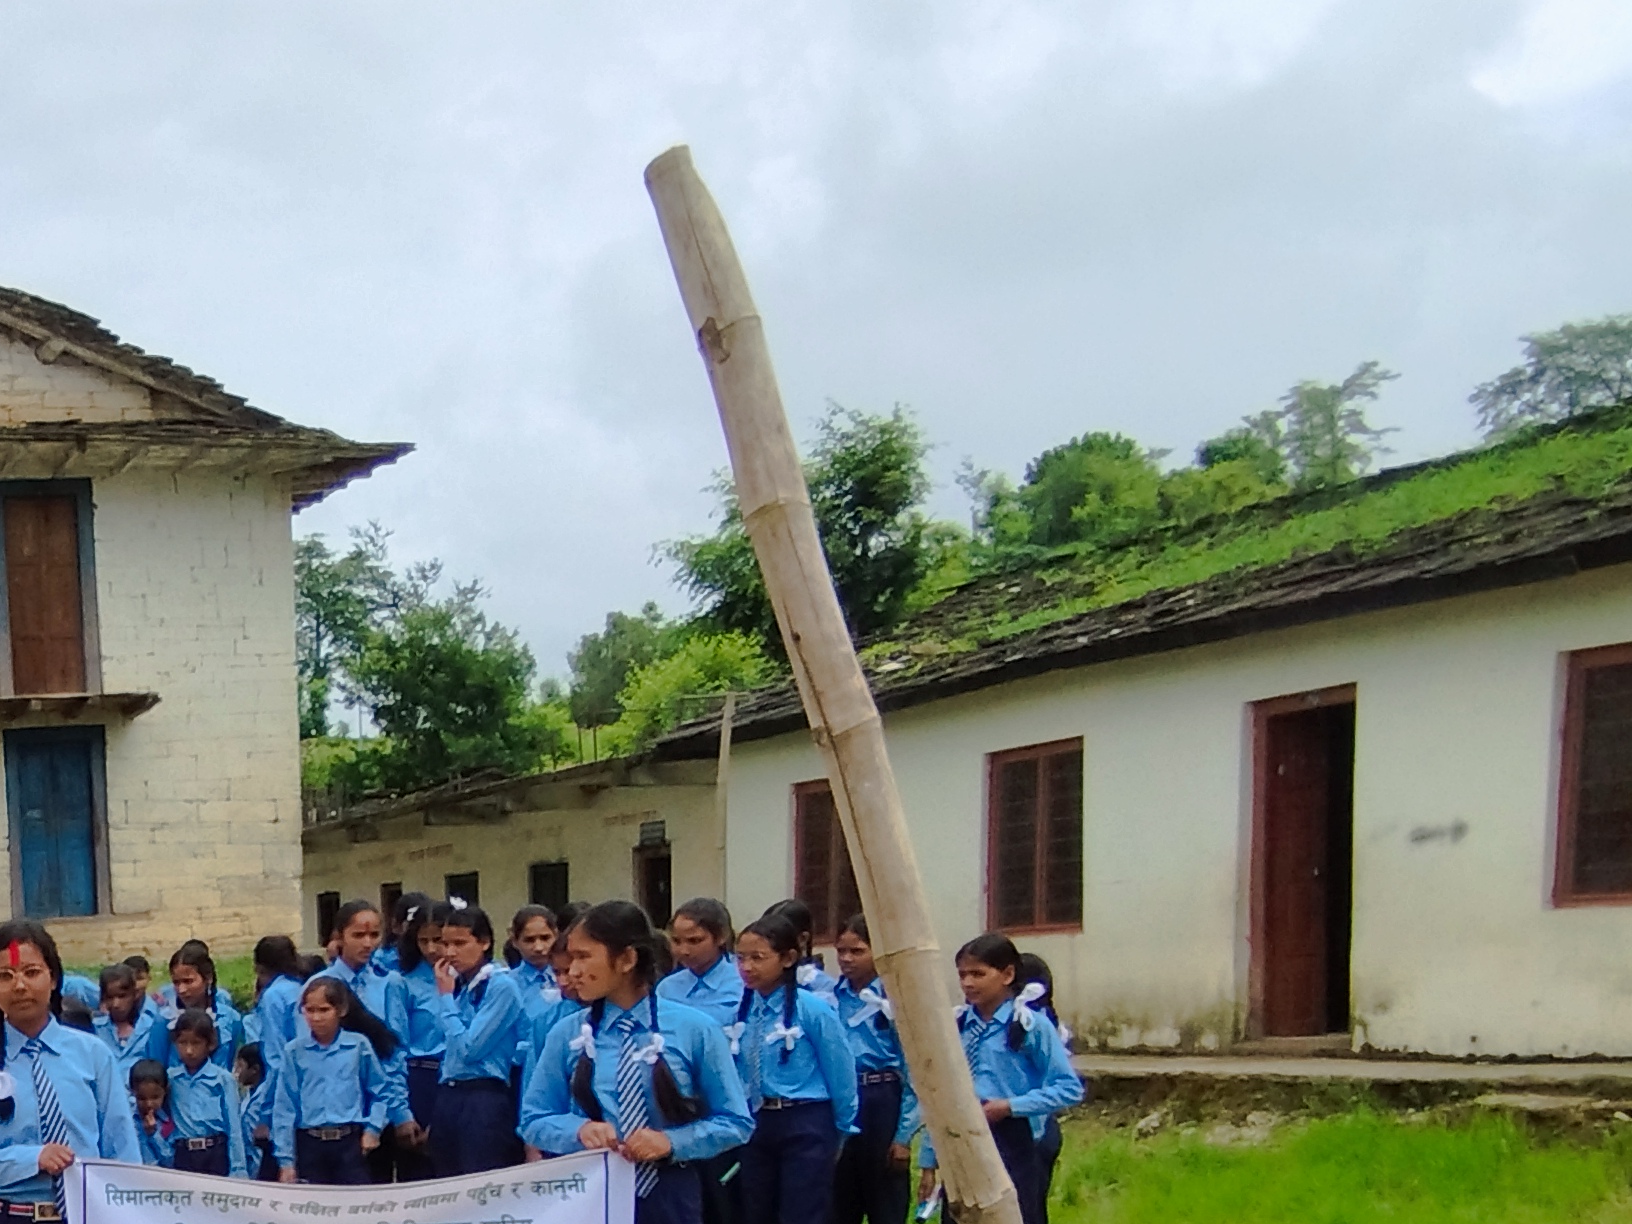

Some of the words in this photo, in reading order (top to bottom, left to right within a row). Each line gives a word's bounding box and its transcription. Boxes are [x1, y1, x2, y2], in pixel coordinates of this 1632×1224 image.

[104, 1182, 194, 1213] सिमान्तकृत
[200, 1190, 263, 1213] समुदाय
[510, 1182, 525, 1199] र
[529, 1172, 588, 1201] कानूनी
